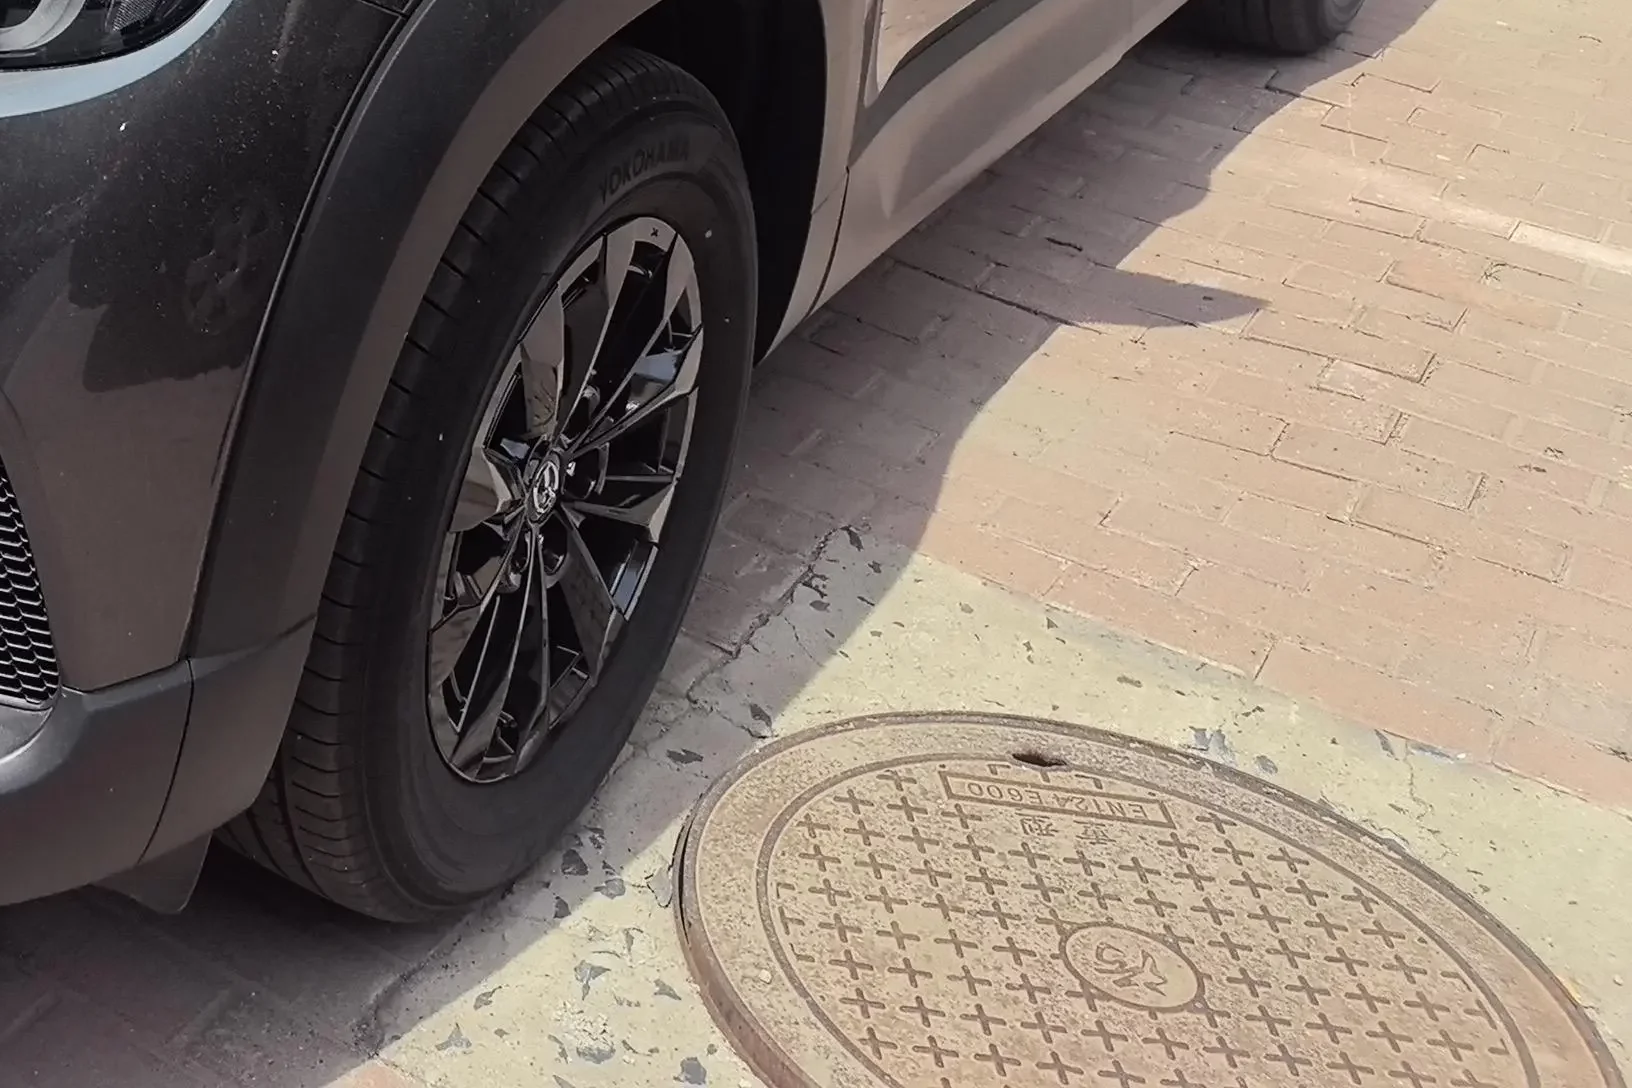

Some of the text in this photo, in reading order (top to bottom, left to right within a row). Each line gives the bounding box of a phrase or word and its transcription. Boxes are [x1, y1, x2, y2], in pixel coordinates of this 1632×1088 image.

[598, 138, 690, 204] YOKOHAMA
[967, 781, 1148, 819] EN124 E600
